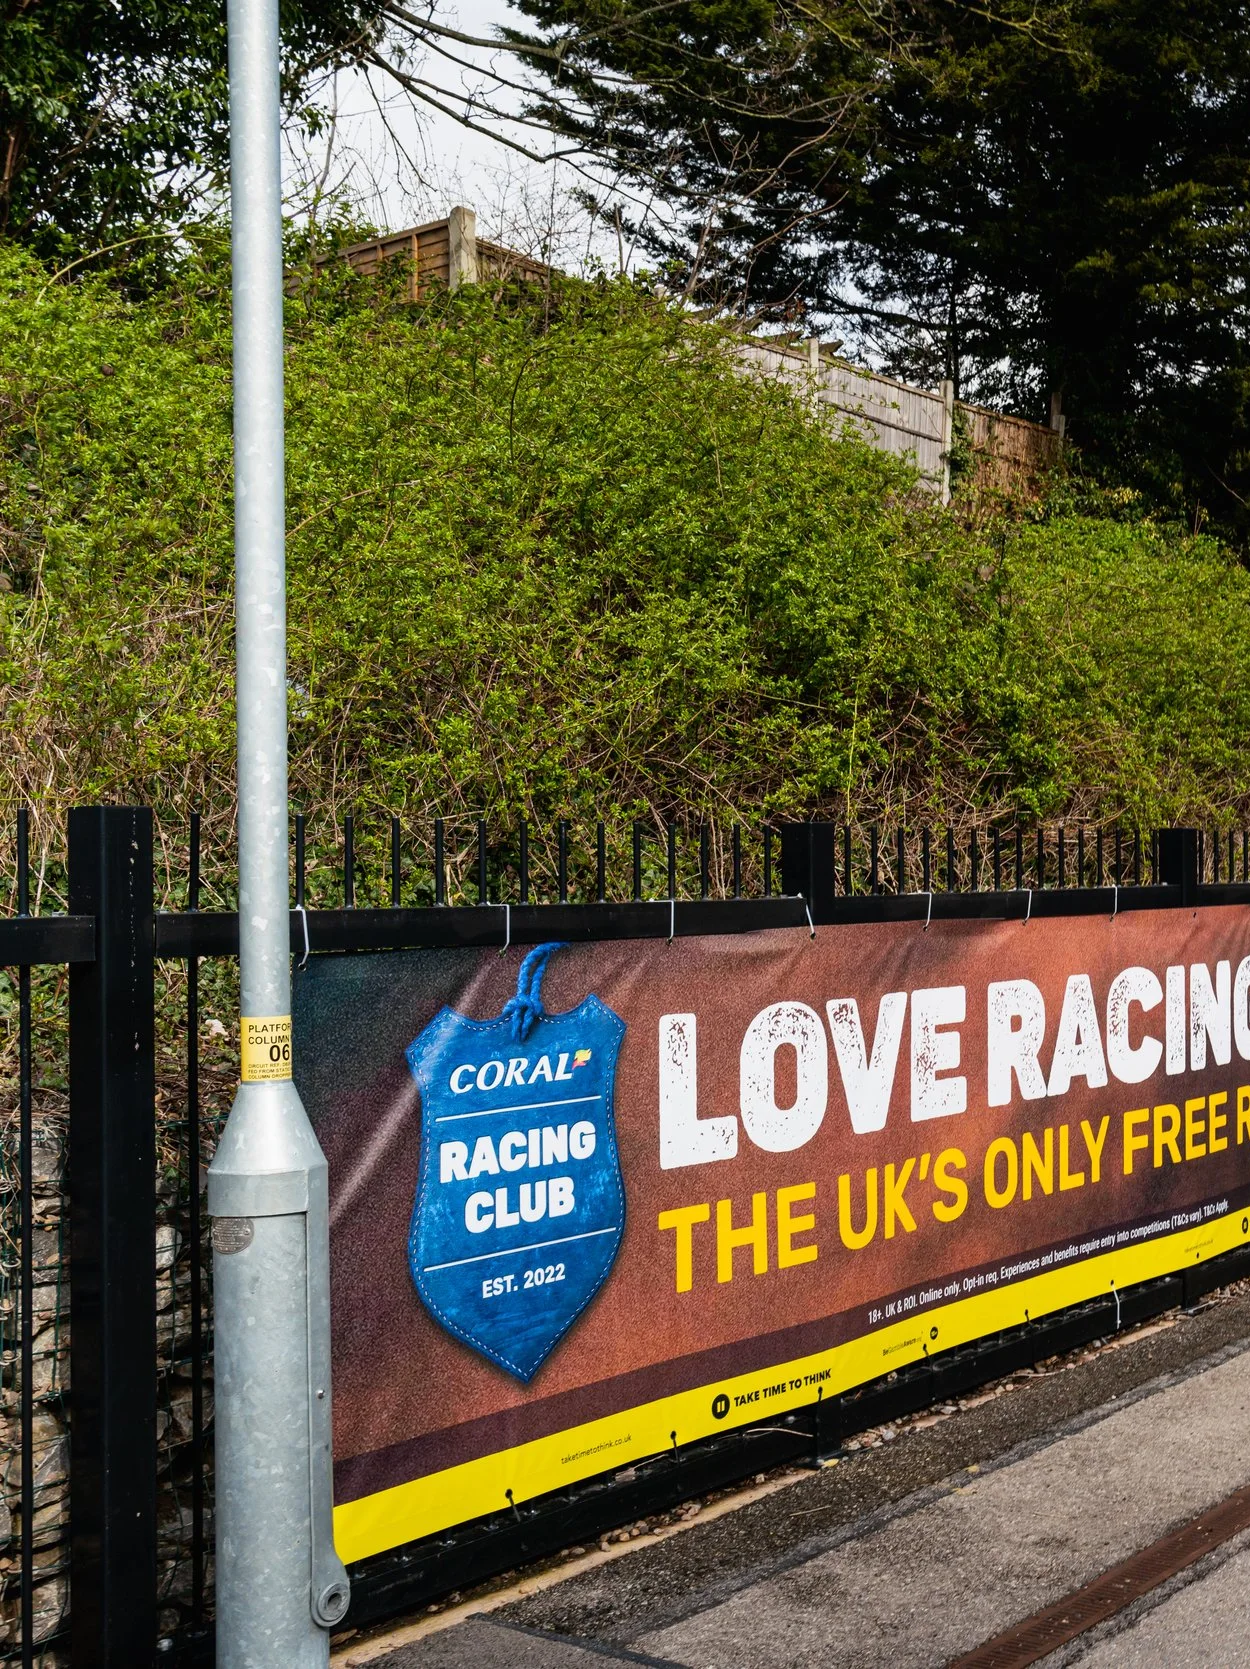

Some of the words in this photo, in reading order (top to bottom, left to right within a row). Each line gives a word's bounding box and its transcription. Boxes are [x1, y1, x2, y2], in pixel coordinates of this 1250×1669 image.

[248, 1023, 291, 1033] PLATFOR
[248, 1035, 290, 1045] COLUMN
[269, 1044, 290, 1062] 06
[449, 1052, 574, 1095] CORAL
[658, 984, 968, 1171] LOVE
[439, 1120, 597, 1184] RACING
[464, 1176, 576, 1234] CLUB
[657, 1181, 820, 1294] THE
[837, 1146, 969, 1251] UK'S
[983, 1115, 1111, 1209] ONLY
[1122, 1090, 1229, 1175] FREE
[482, 1273, 519, 1299] EST.
[523, 1263, 566, 1289] 2022
[868, 1309, 884, 1325] 18+.
[885, 1302, 896, 1318] UK
[897, 1300, 903, 1314] &
[903, 1295, 918, 1311] ROI.
[919, 1288, 943, 1305] Online
[944, 1281, 961, 1297] only.
[963, 1274, 984, 1292] Opt-in
[985, 1271, 999, 1284] req.
[1000, 1257, 1040, 1280] Experiences
[1041, 1251, 1053, 1267] and
[1054, 1244, 1079, 1262] benefits
[1079, 1238, 1100, 1254] require
[1100, 1234, 1116, 1248] entry
[1117, 1230, 1129, 1243] into
[1130, 1219, 1170, 1238] competitions
[733, 1390, 760, 1407] TAKE
[762, 1382, 787, 1398] TIME
[789, 1378, 802, 1391] TO
[803, 1368, 832, 1386] THINK
[561, 1433, 632, 1465] taketimetothink.co.uk
